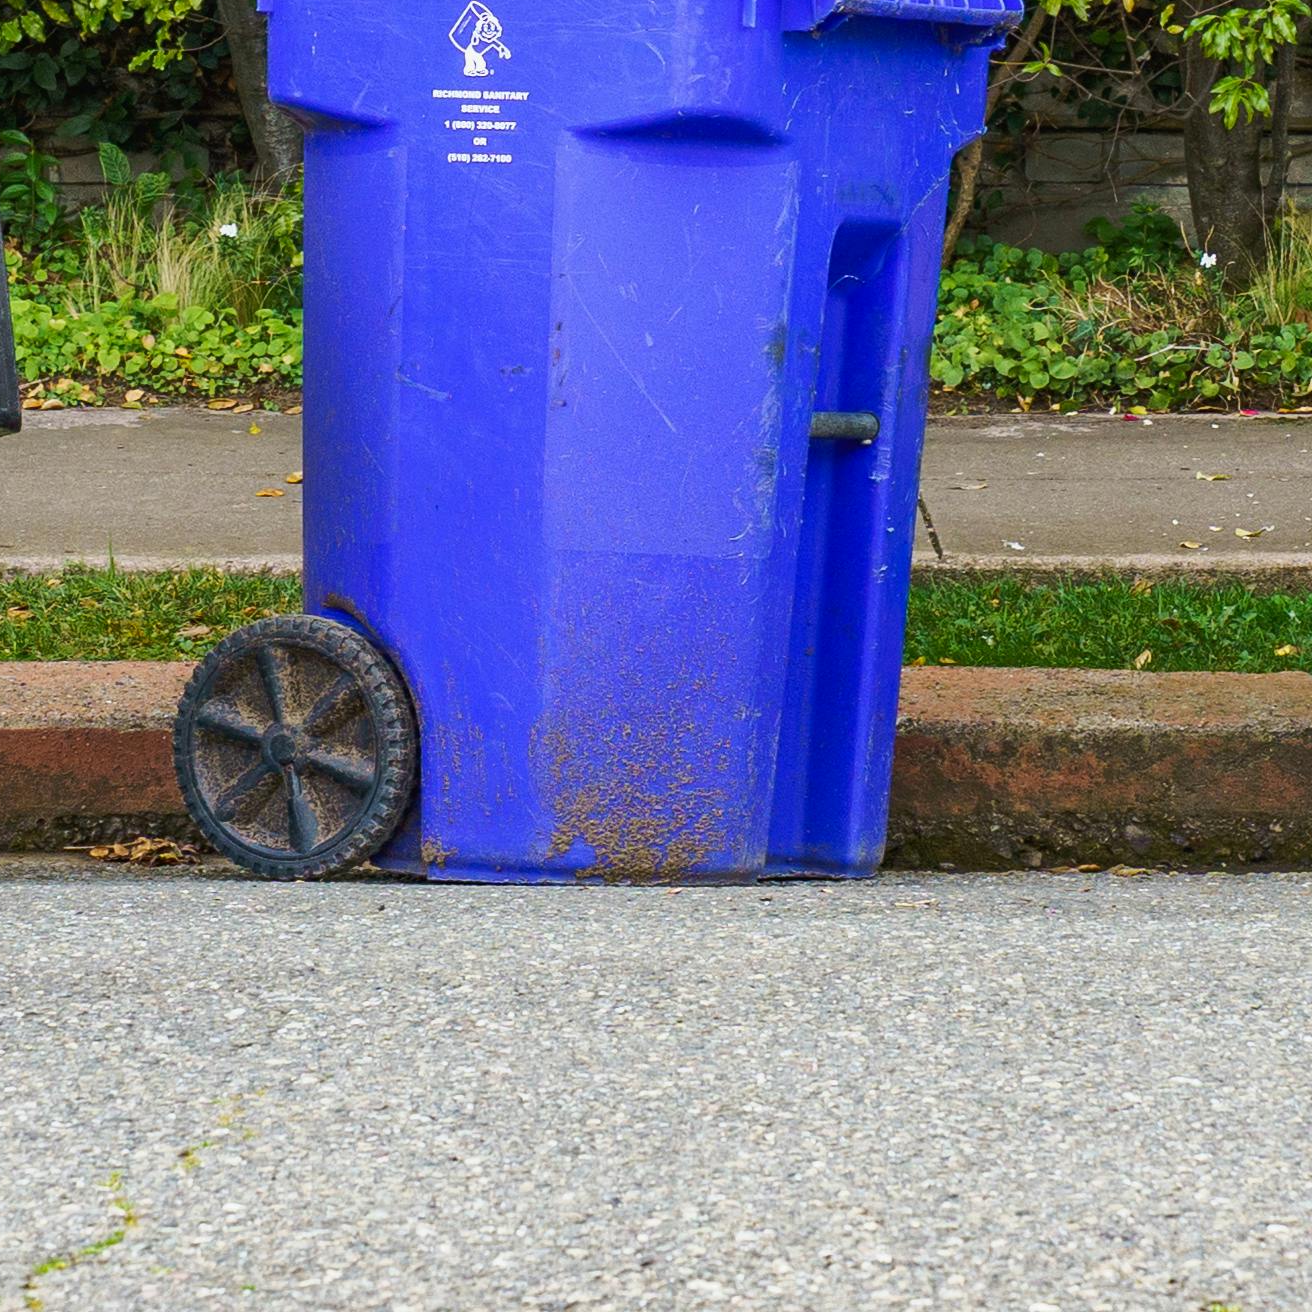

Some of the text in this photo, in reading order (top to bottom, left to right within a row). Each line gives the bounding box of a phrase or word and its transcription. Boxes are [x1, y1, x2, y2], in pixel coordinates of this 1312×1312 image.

[432, 89, 529, 100] RICHMOND SANITARY
[461, 104, 500, 113] SERVICE
[444, 120, 450, 128] 1
[473, 137, 487, 146] OR
